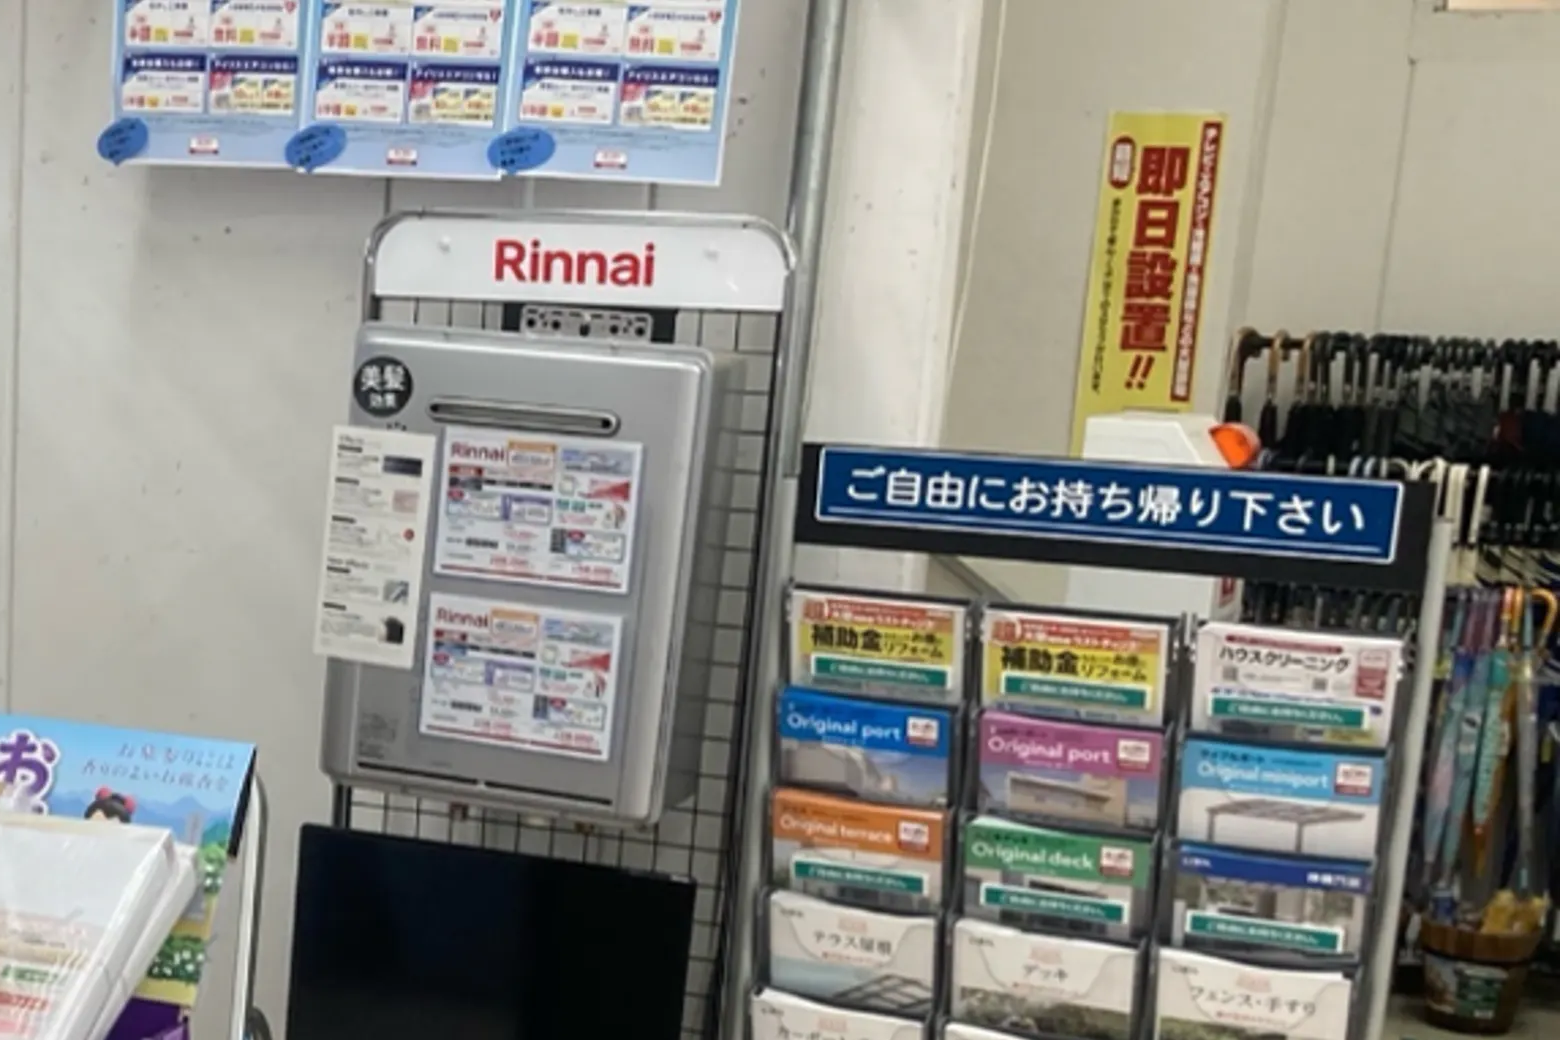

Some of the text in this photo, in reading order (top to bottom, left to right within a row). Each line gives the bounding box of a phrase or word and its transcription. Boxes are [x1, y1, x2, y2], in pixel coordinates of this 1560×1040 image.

[493, 240, 656, 288] Rinnai
[450, 441, 505, 463] Rinnai
[845, 466, 1366, 535] ご自由にお持ち帰り下さい
[437, 607, 489, 628] Rinnai
[810, 623, 883, 653] 補助金
[1000, 645, 1080, 676] 補助金
[1080, 662, 1148, 683] リフォーム
[1219, 646, 1351, 673] ハウスクリーニング
[786, 710, 902, 743] Original port
[988, 735, 1111, 767] Original port
[1197, 760, 1329, 790] Original miniport
[779, 813, 894, 844] Original terrace
[971, 840, 1094, 870] Original deck
[1024, 964, 1068, 980] デッキ
[1192, 985, 1317, 1016] フェンス・手すり
